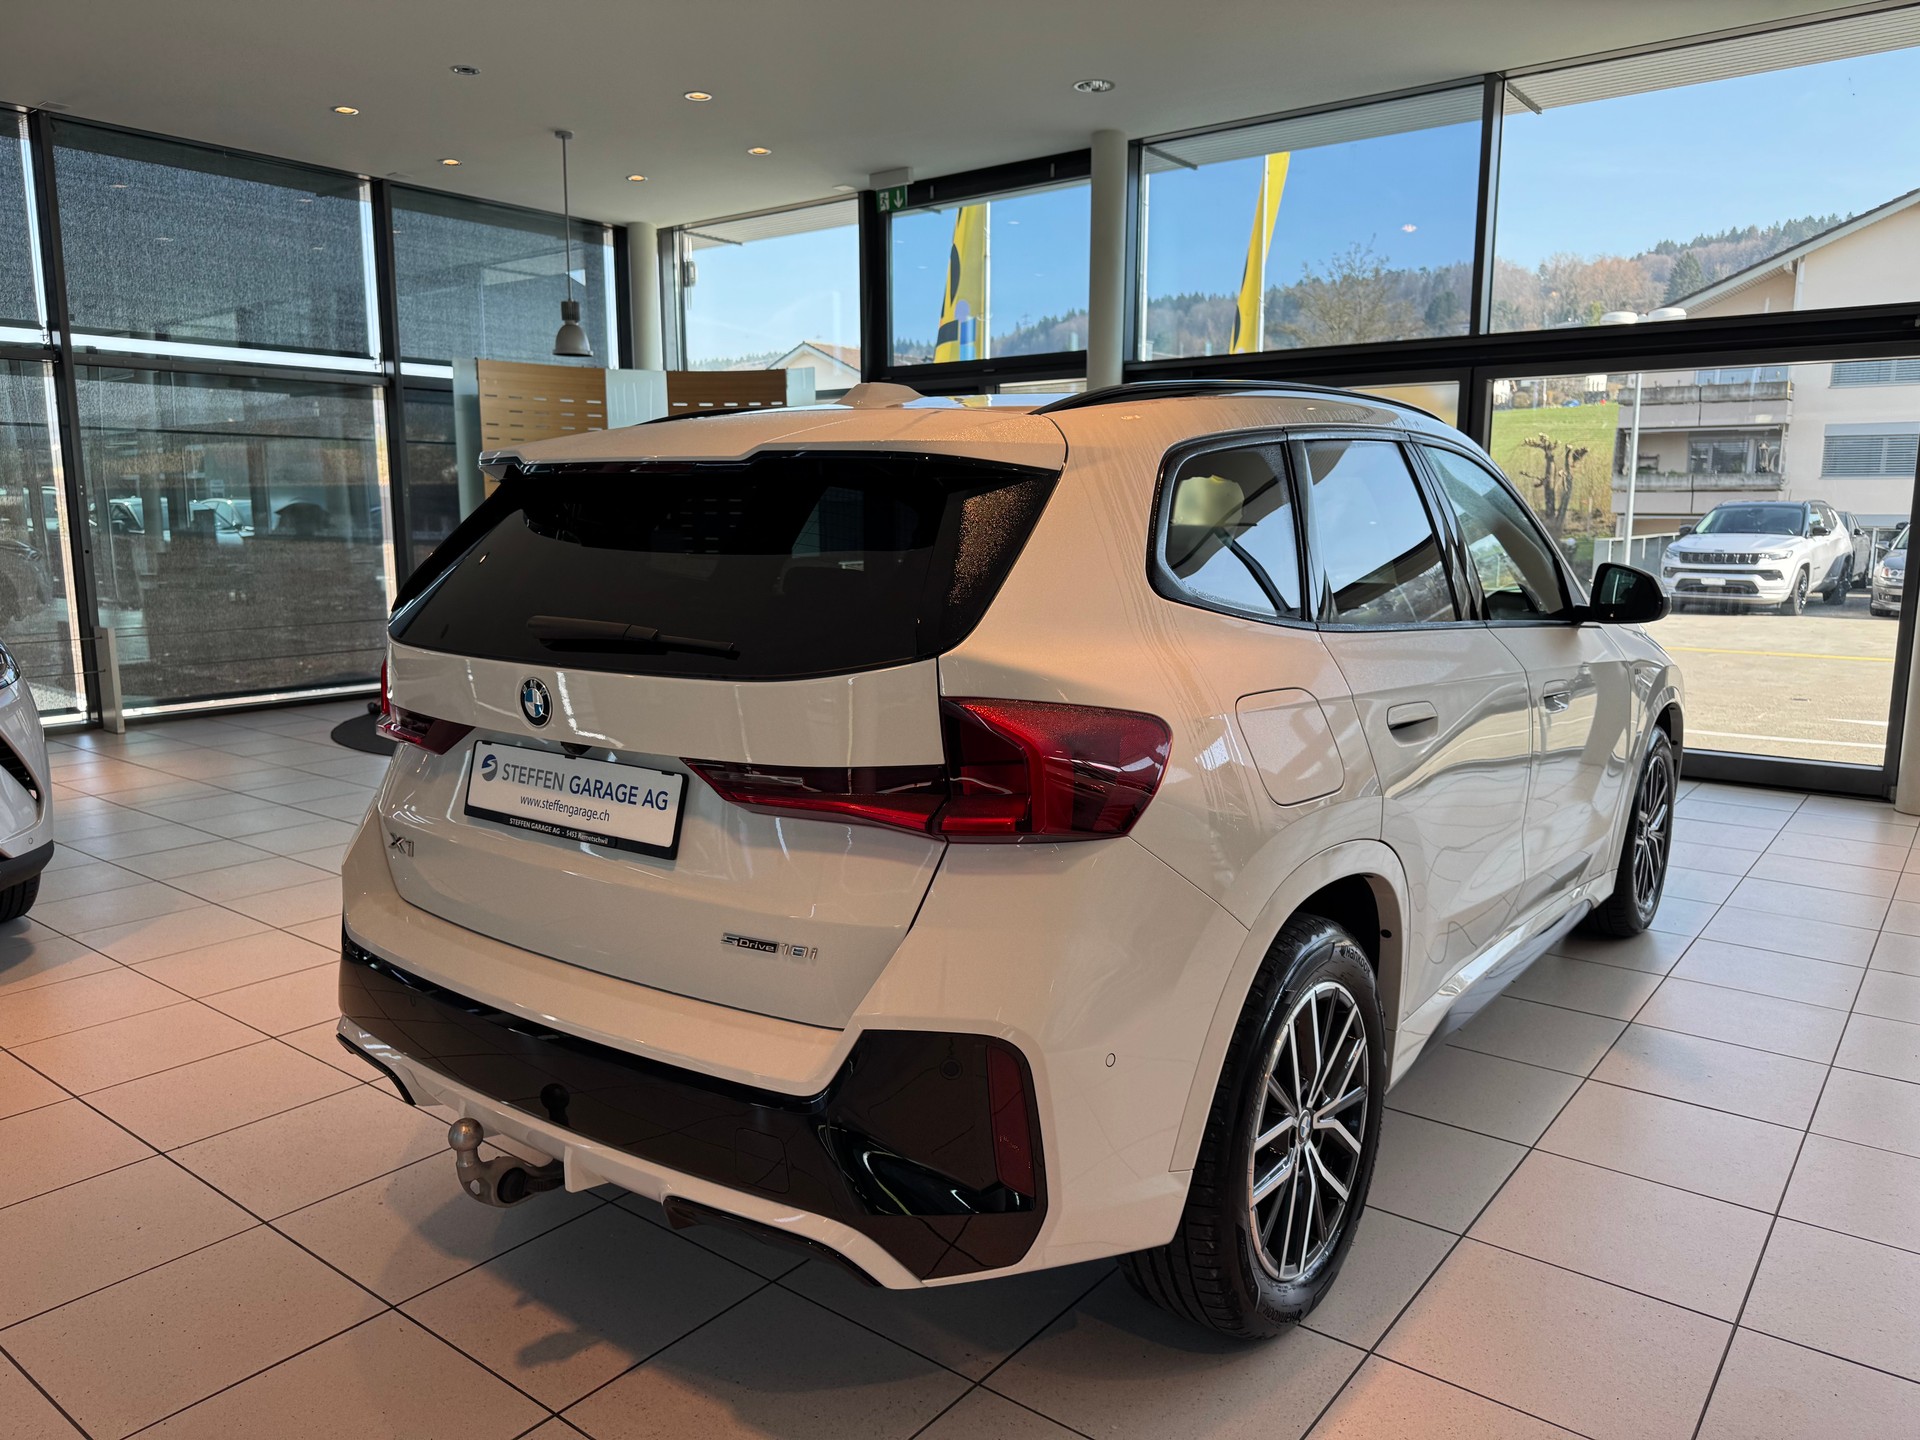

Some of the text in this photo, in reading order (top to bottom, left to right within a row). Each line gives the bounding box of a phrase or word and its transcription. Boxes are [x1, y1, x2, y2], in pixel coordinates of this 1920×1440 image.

[522, 679, 547, 696] BMW
[502, 763, 669, 810] STEFFEN GARAGE AG
[520, 794, 610, 821] www.steffengarage.ch
[509, 817, 531, 828] STEFFEN
[531, 822, 552, 832] GARAGE
[388, 832, 414, 857] X1
